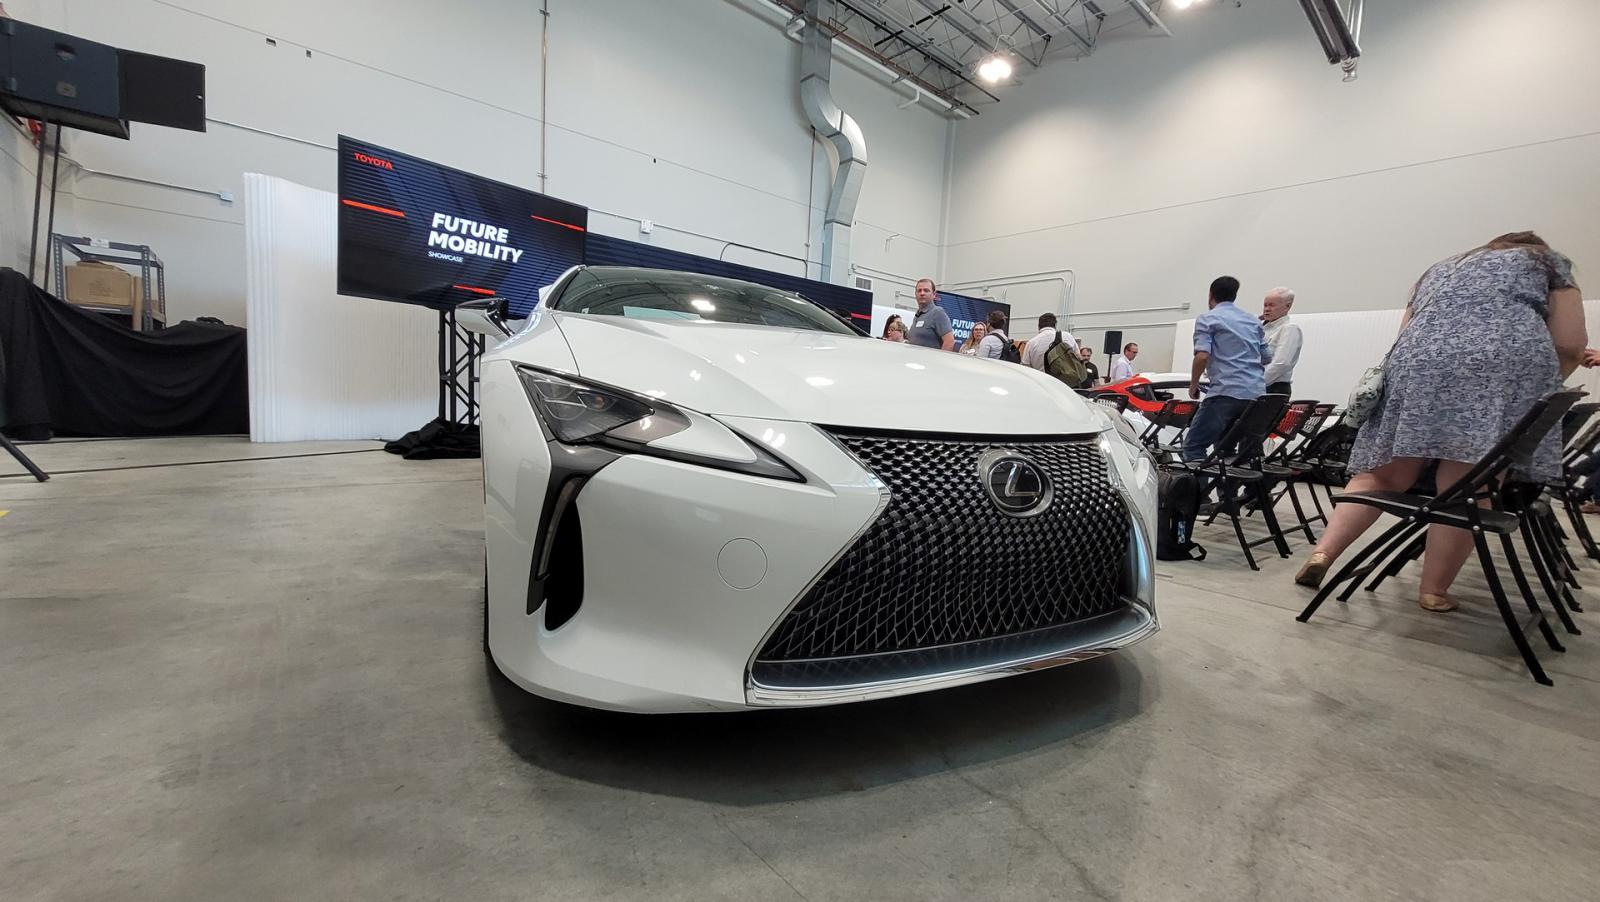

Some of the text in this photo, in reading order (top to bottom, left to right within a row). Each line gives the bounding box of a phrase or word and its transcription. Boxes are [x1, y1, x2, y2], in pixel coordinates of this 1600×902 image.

[353, 152, 393, 170] TOYOTA
[432, 212, 509, 243] FUTURE
[428, 230, 523, 263] MOBILITY
[428, 251, 464, 263] SHOWCASE
[952, 318, 975, 330] FUTUR
[952, 328, 970, 339] MOBI
